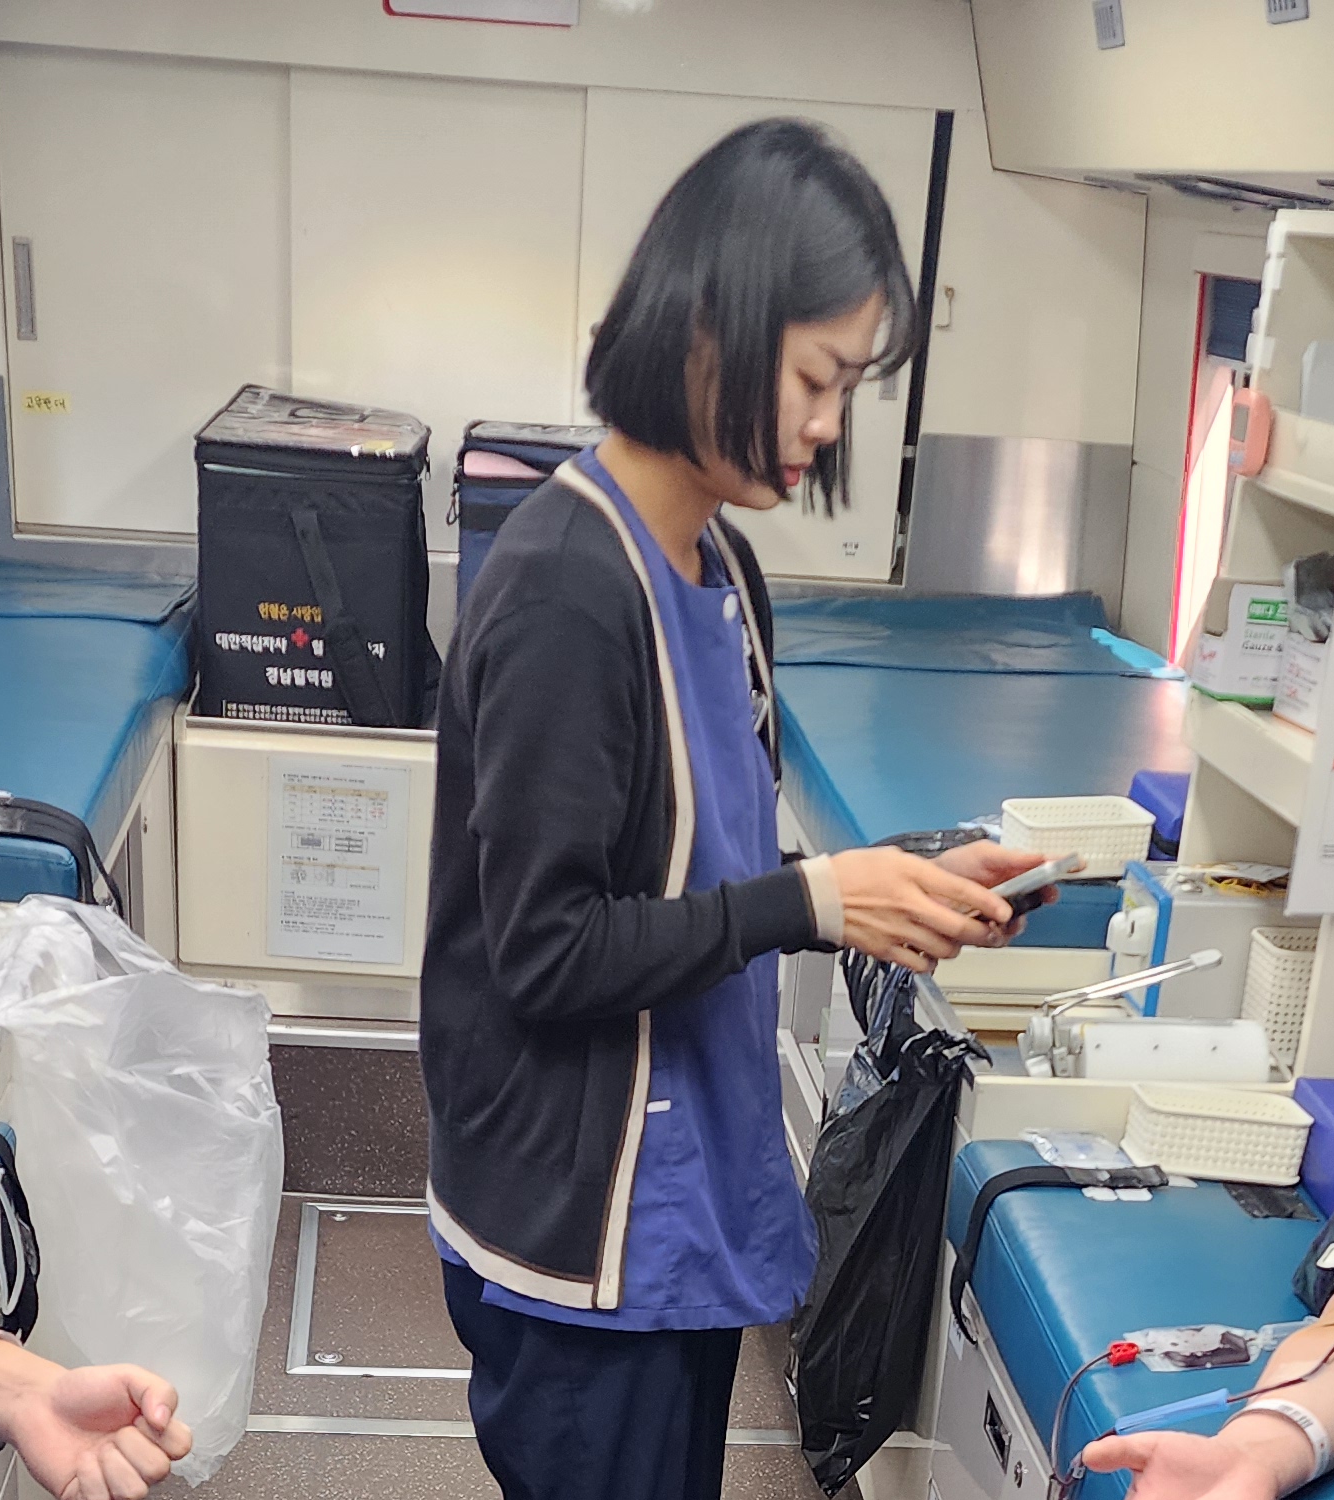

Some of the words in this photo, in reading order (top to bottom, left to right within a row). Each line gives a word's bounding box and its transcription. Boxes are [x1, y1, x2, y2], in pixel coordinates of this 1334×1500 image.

[258, 602, 289, 621] 헌혈은
[292, 605, 323, 623] 사랑입
[215, 632, 288, 655] 대한적십자사
[1242, 640, 1274, 651] Gauze
[265, 667, 334, 688] 경남혈액원
